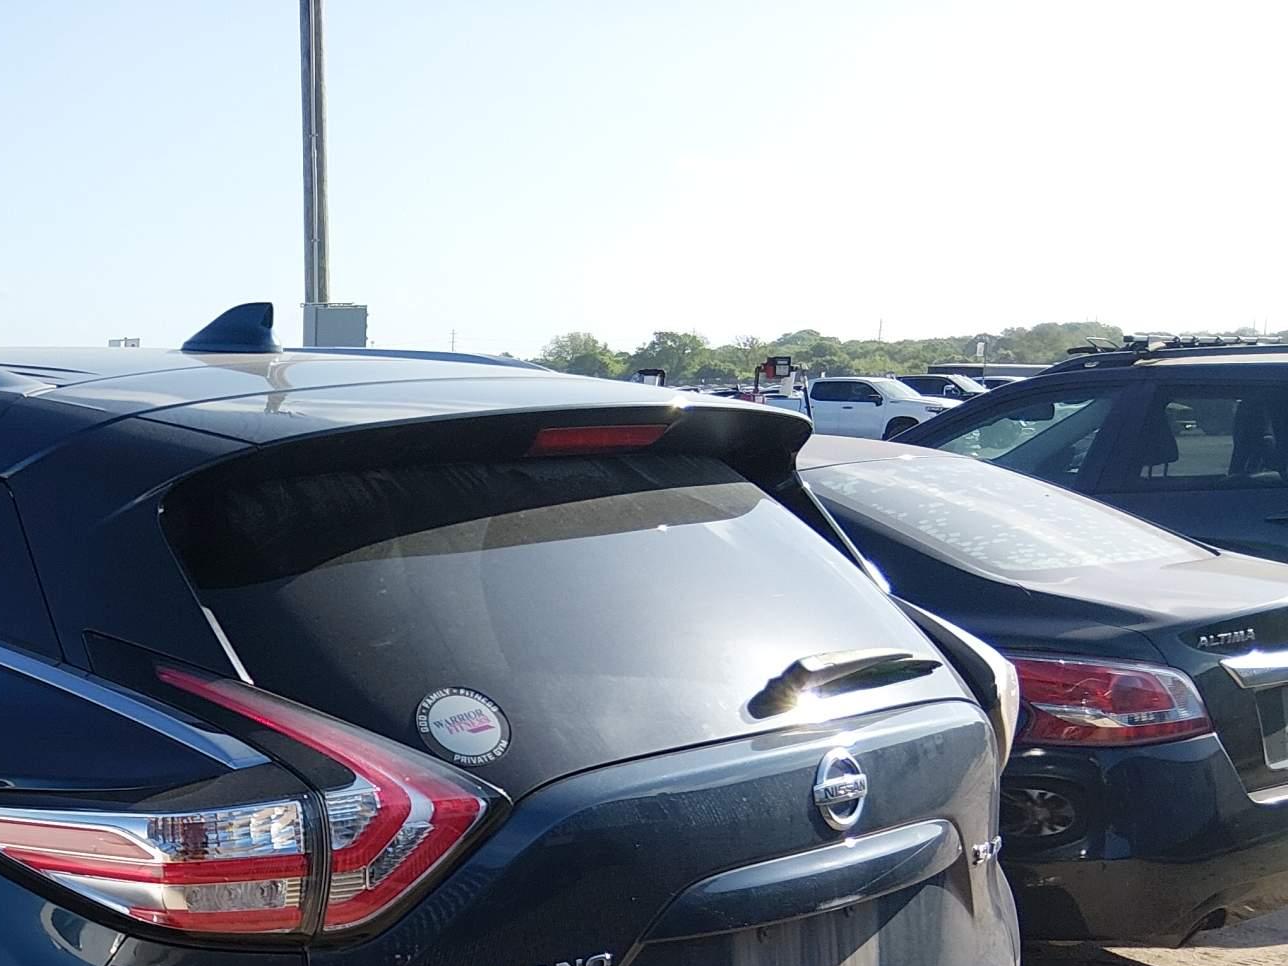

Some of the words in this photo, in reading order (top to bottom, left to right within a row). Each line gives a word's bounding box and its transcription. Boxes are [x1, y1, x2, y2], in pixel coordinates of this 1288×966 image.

[1197, 628, 1255, 648] ALTIMA
[422, 688, 450, 709] FAMILY
[433, 709, 484, 728] WARRIOR
[453, 752, 495, 764] PRIVATE
[823, 779, 866, 799] NISSAN
